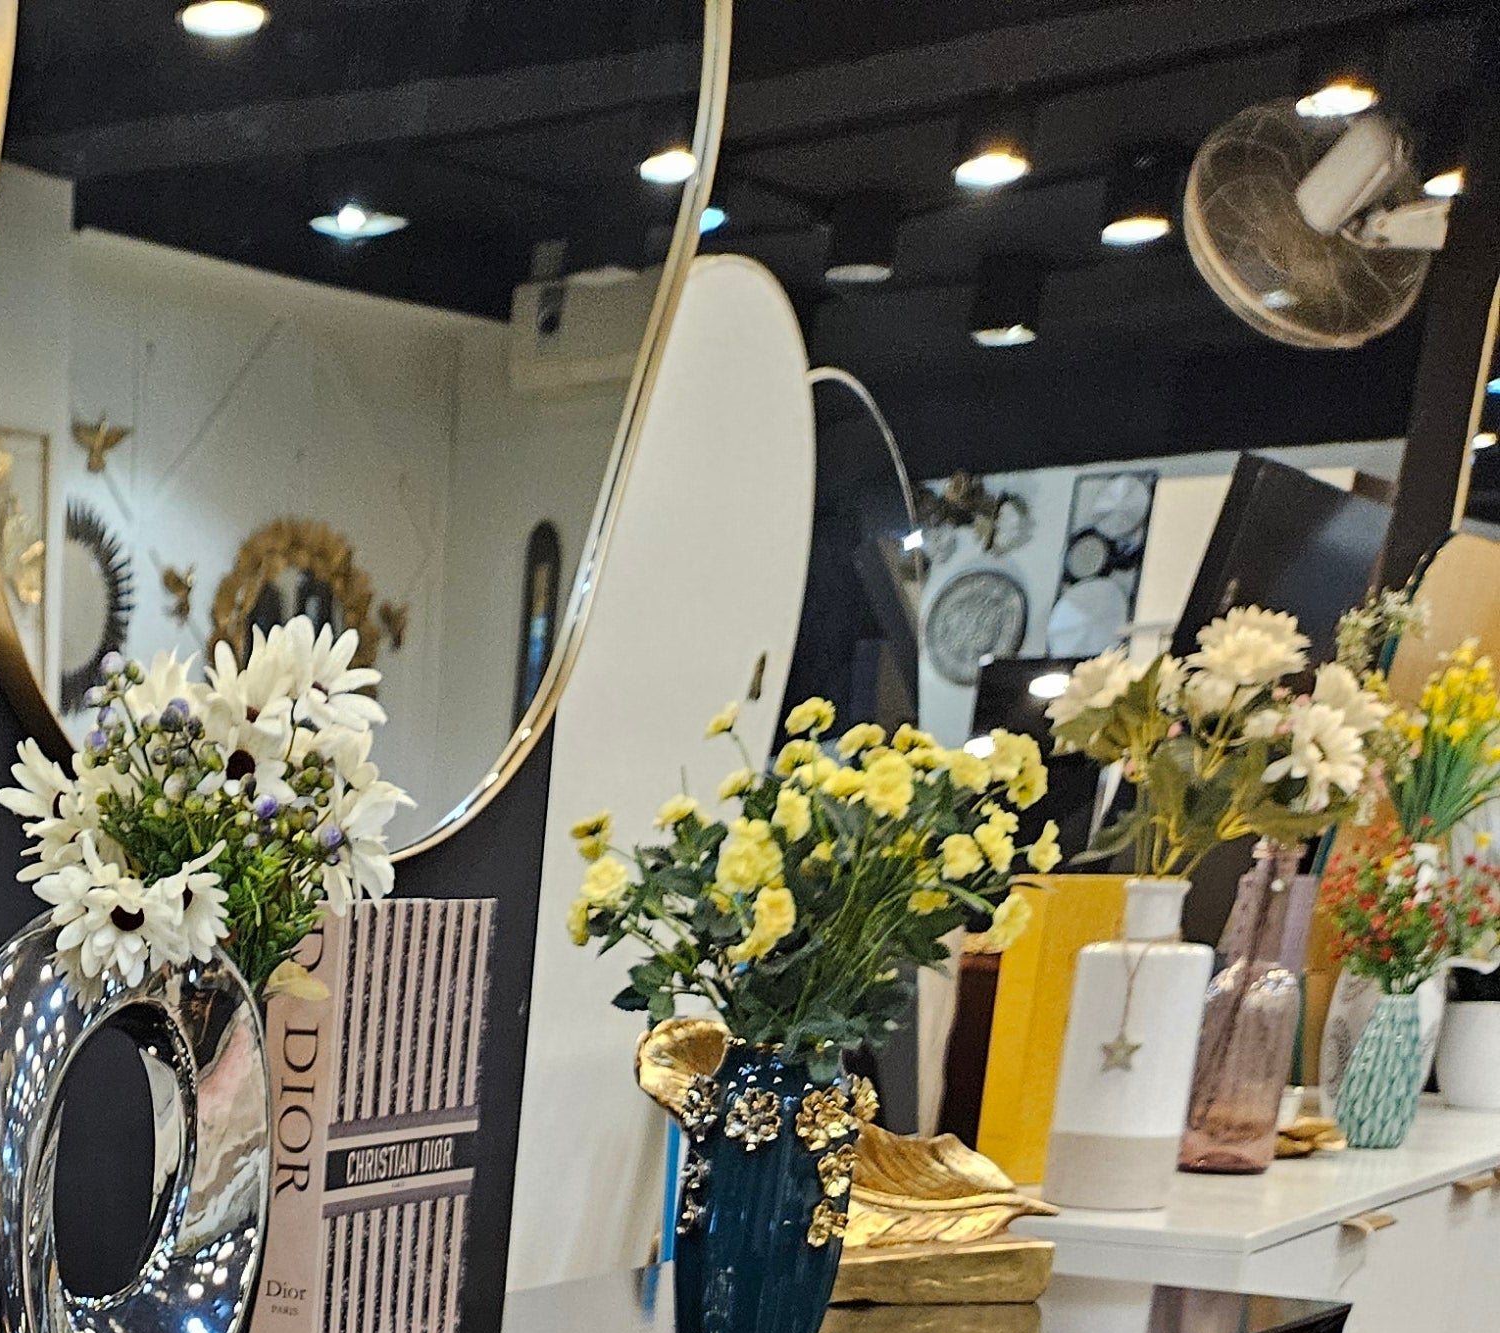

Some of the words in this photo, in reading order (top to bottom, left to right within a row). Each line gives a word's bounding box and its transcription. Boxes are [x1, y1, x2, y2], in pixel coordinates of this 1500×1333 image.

[275, 1021, 319, 1199] DIOR
[346, 1142, 419, 1185] CHRISTIAN
[420, 1137, 454, 1173] DIOR
[265, 1279, 307, 1301] Dior
[271, 1304, 299, 1316] PARIS
